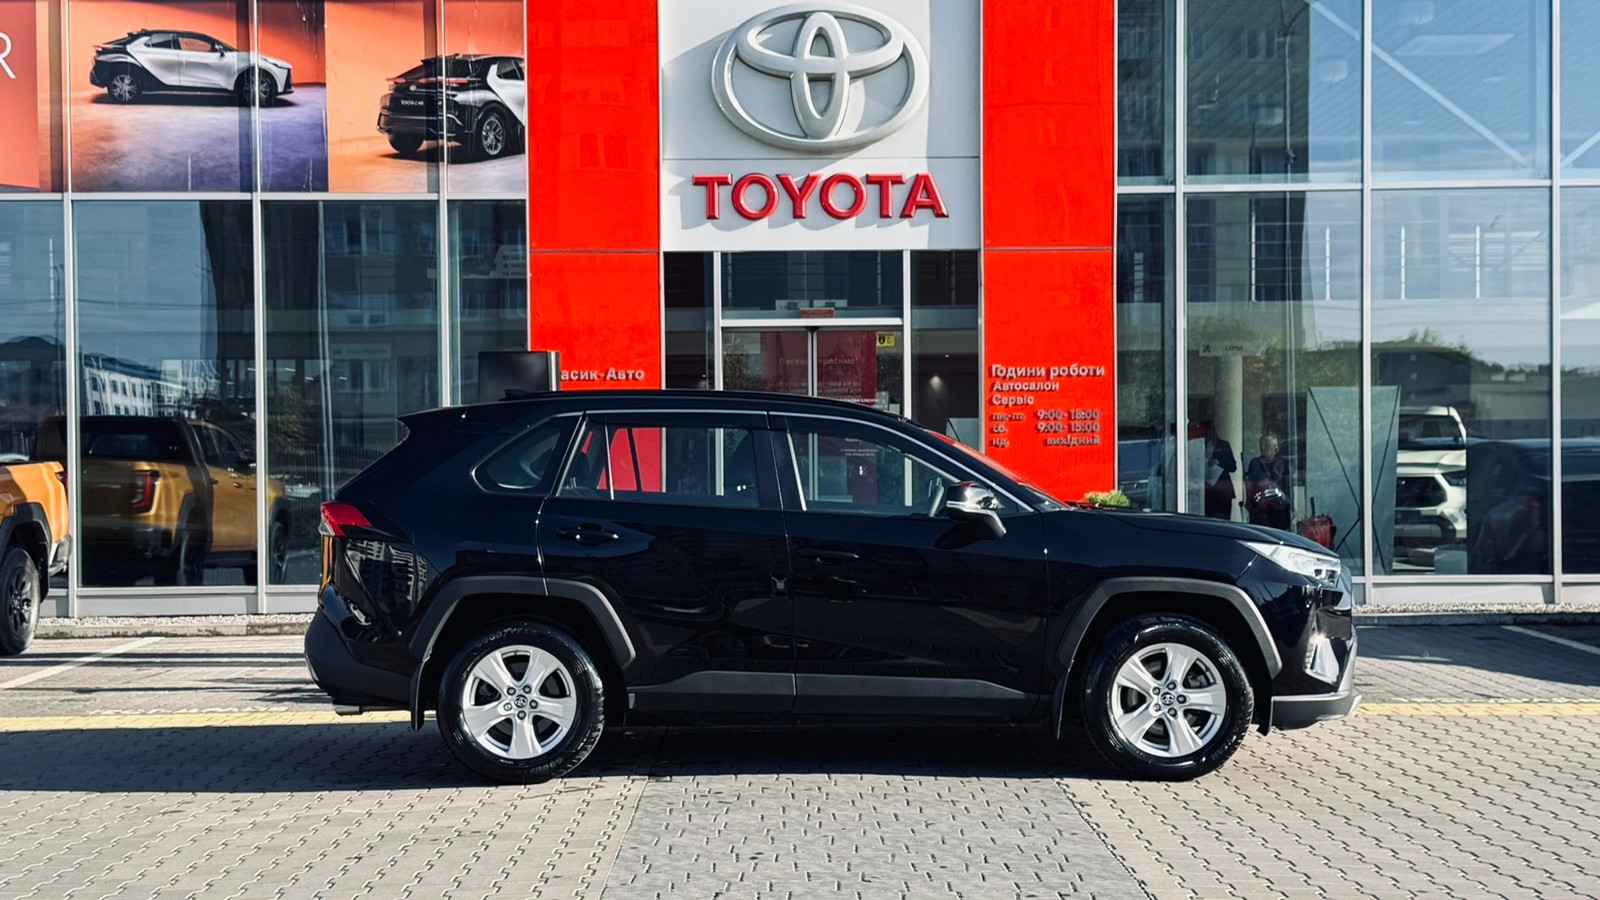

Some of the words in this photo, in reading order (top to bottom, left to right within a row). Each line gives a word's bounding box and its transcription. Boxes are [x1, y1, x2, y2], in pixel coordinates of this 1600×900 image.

[692, 172, 949, 220] TOYOTA
[560, 368, 645, 381] асик-Авто
[991, 364, 1045, 378] Години
[1050, 363, 1105, 379] роботи
[993, 381, 1060, 391] Автосалон
[992, 394, 1034, 407] Сервіс
[1046, 433, 1101, 447] вихідний
